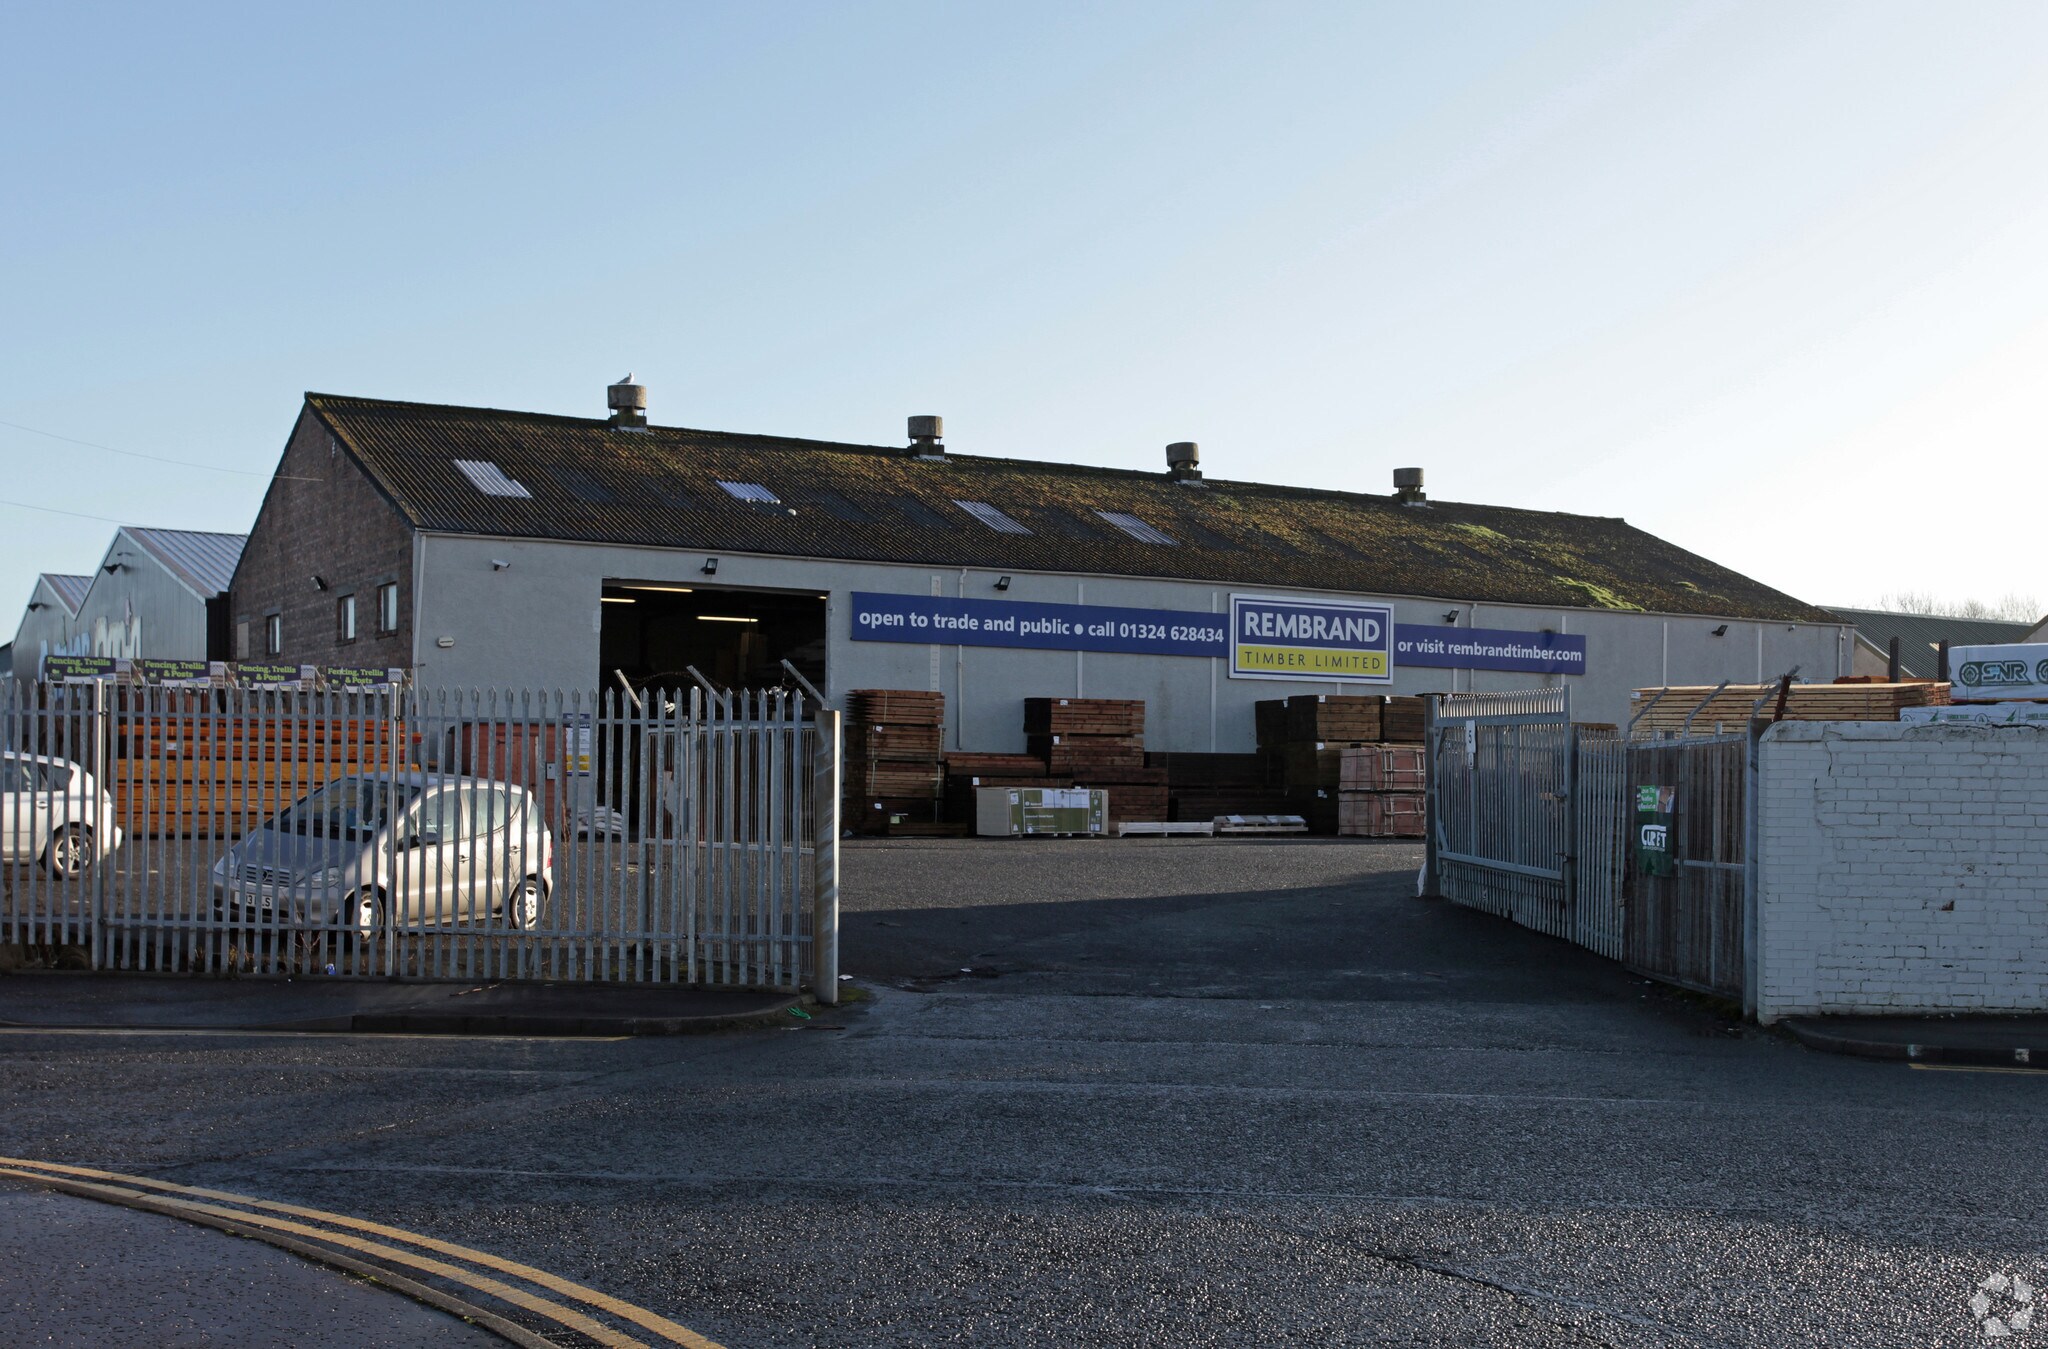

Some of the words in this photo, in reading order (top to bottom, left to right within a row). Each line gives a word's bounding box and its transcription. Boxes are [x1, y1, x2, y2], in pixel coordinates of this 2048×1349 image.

[859, 612, 904, 629] open
[909, 612, 928, 627] to
[933, 614, 979, 630] trade
[983, 616, 1015, 632] and
[1020, 617, 1070, 636] public
[1088, 621, 1115, 637] call
[1119, 622, 1166, 639] 01324
[1170, 625, 1224, 643] 628434
[1245, 611, 1380, 643] REMBRAND
[1397, 640, 1413, 653] or
[1416, 638, 1445, 655] visit
[1448, 639, 1582, 662] rembrandtimber.com
[84, 657, 111, 666] Trellis
[1244, 651, 1306, 667] TIMBER
[1314, 655, 1381, 670] LIMITED
[67, 666, 74, 674] &
[75, 666, 98, 674] Posts
[180, 661, 205, 670] Trellis
[271, 665, 297, 674] Trellis
[163, 669, 170, 677] &
[171, 669, 193, 678] Posts
[360, 668, 384, 677] Trellis
[256, 673, 262, 681] &
[263, 673, 285, 682] Posts
[345, 676, 351, 684] &
[352, 676, 373, 684] Posts
